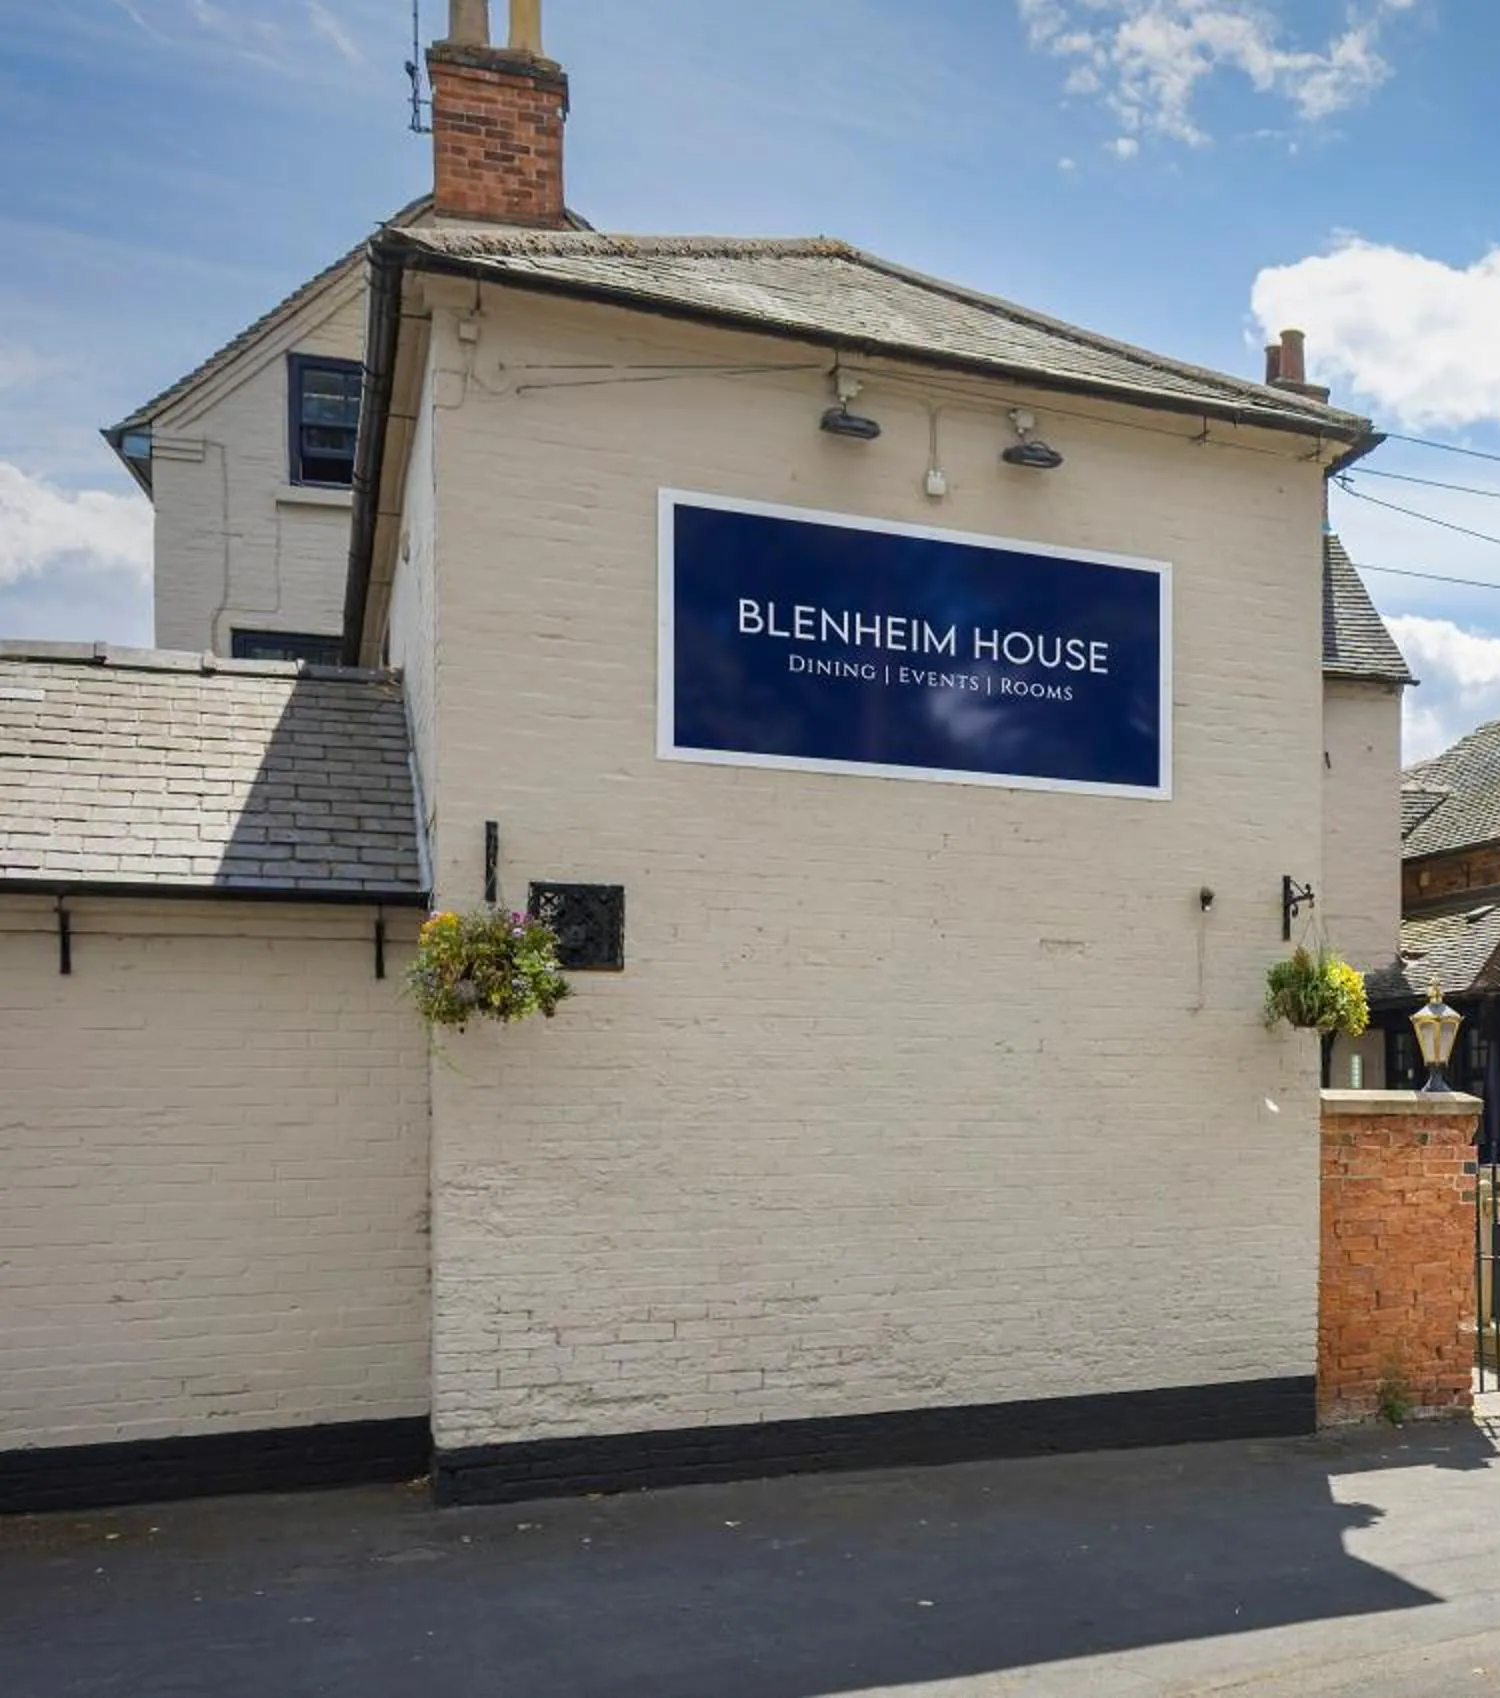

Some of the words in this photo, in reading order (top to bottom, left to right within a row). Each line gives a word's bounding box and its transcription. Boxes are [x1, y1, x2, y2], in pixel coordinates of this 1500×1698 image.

[738, 597, 957, 657] BLENHEIM
[973, 627, 1110, 674] HOUSE
[788, 654, 876, 680] DINING
[898, 667, 980, 691] EVENTS
[1000, 677, 1073, 701] ROOMS
